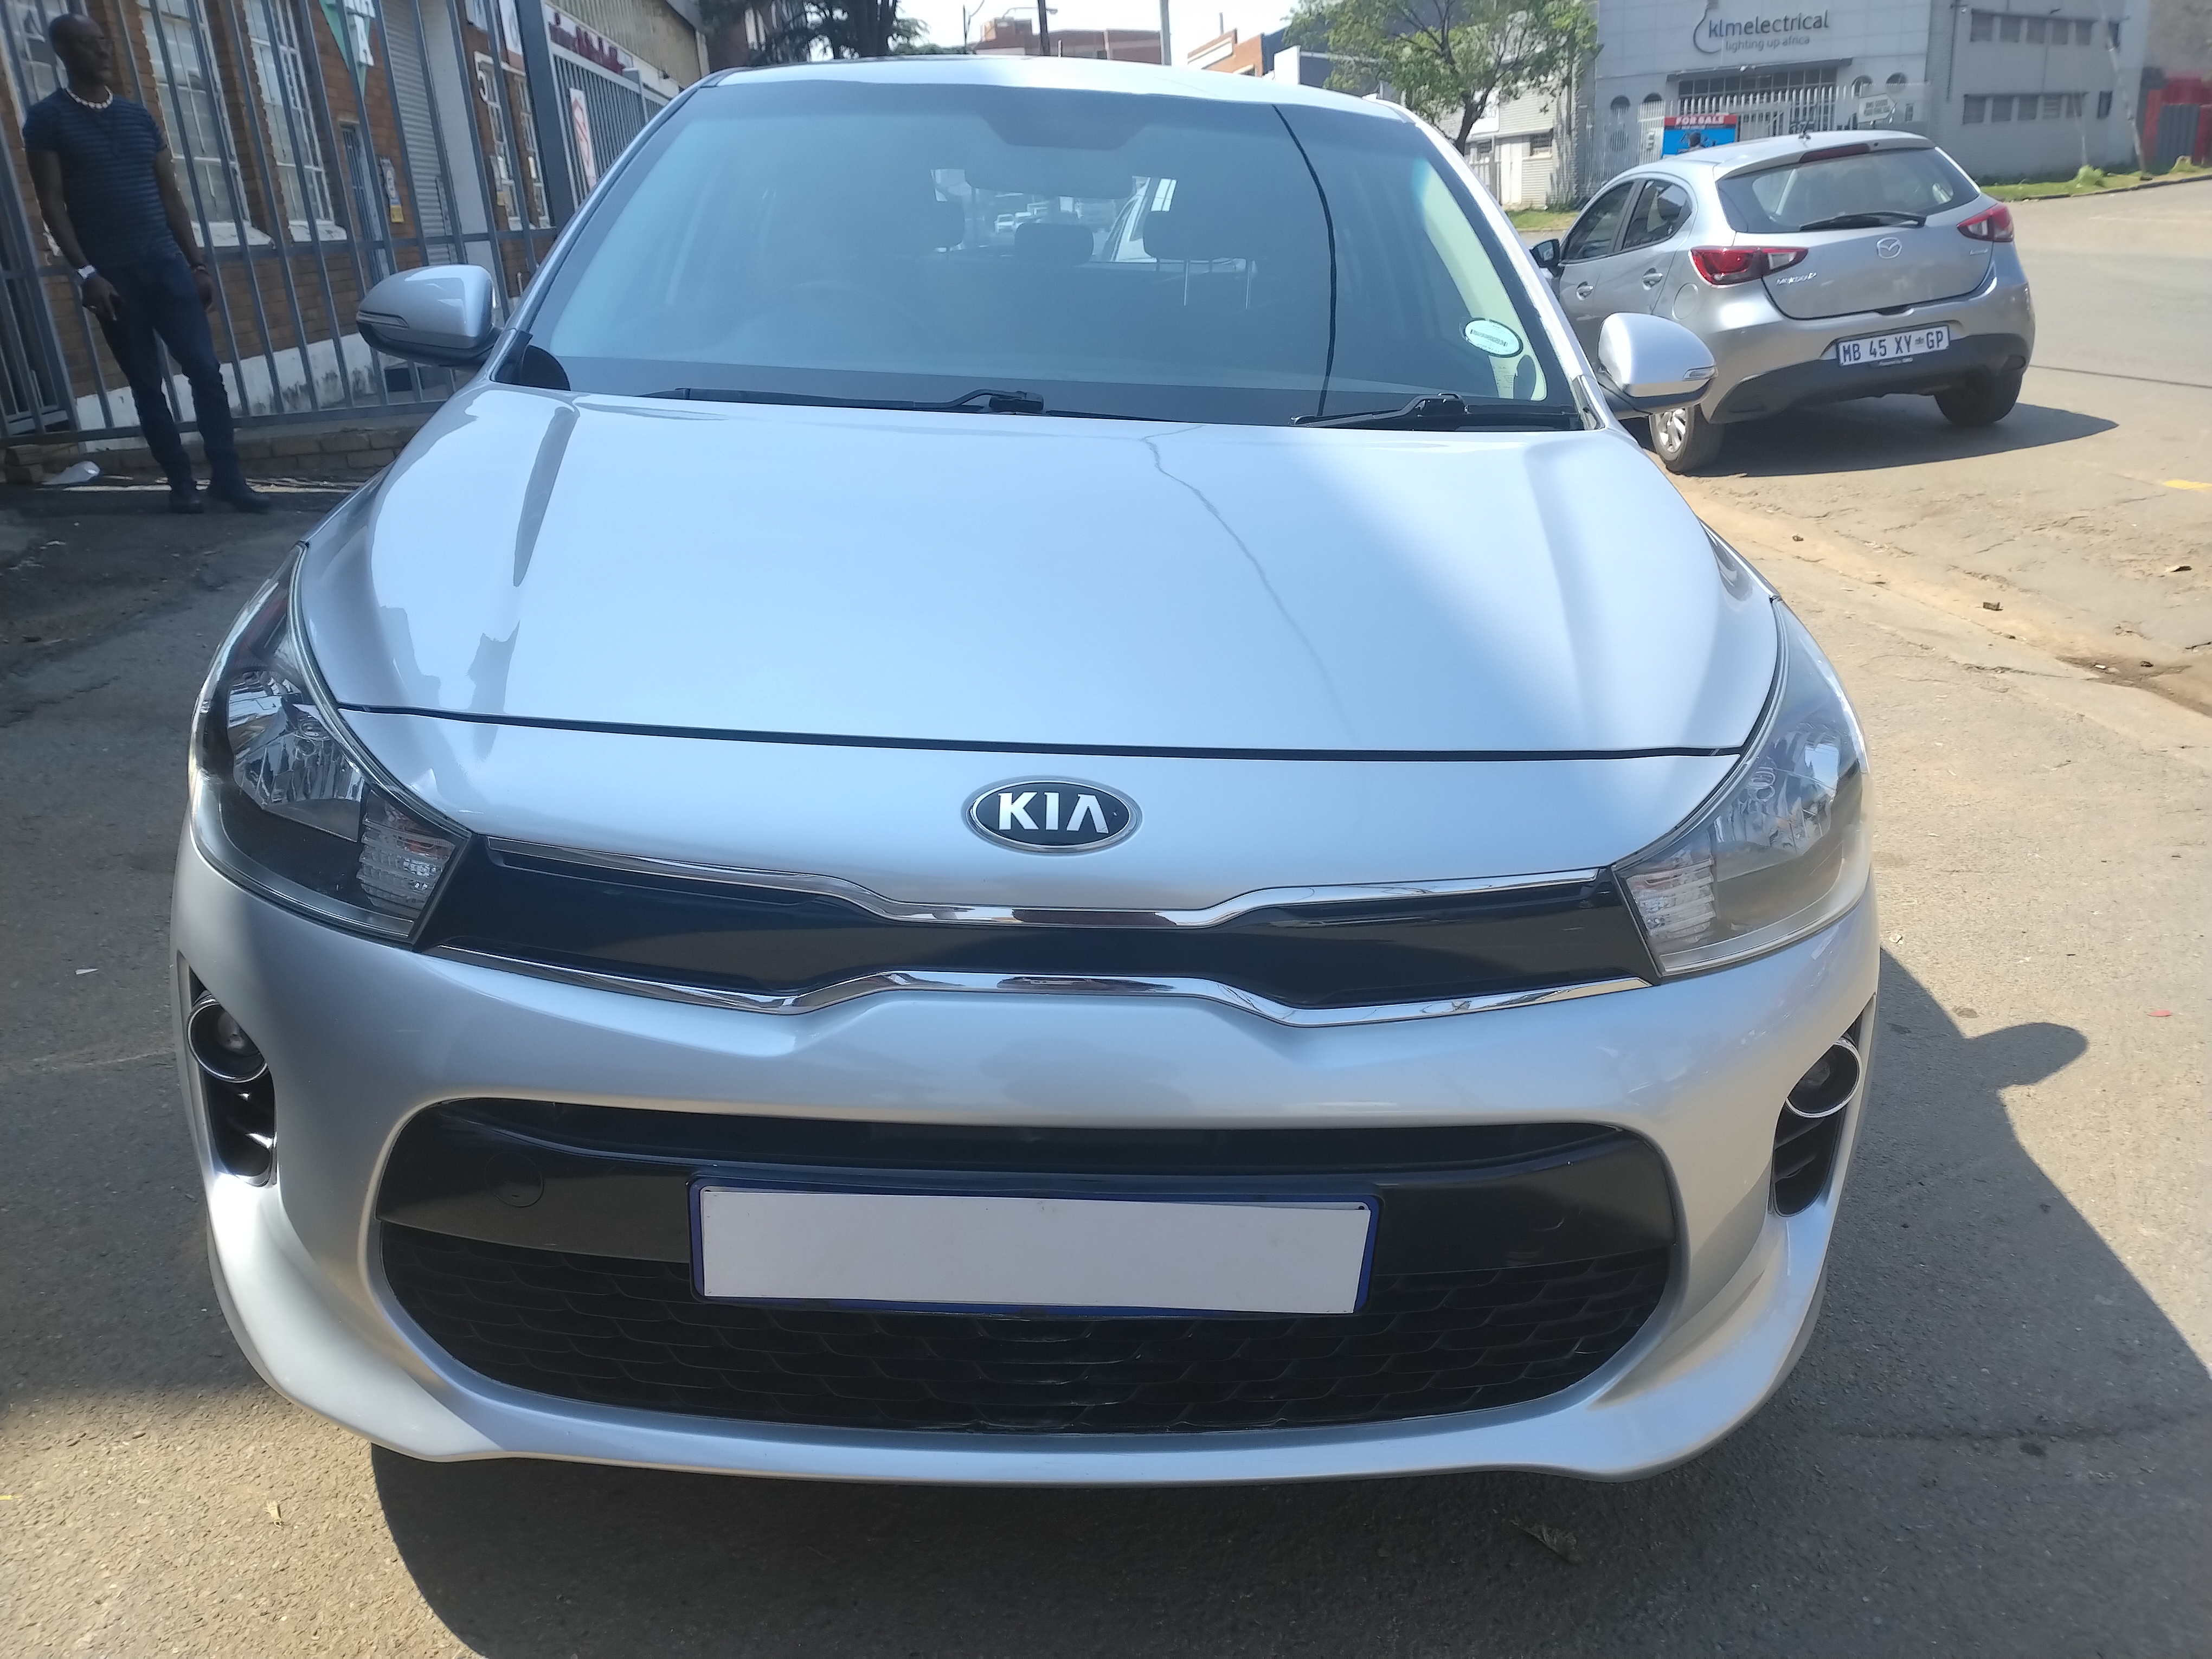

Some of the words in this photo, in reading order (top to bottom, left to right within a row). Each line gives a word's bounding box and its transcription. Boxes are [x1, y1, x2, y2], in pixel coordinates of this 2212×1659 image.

[1726, 40, 1764, 53] lighting
[1767, 39, 1779, 49] up
[1782, 35, 1810, 46] africa
[1675, 116, 1697, 125] FOR
[1843, 344, 1861, 362] MB
[1869, 339, 1887, 357] 45
[1895, 335, 1912, 355] XY
[1926, 330, 1944, 349] GP
[998, 792, 1109, 834] KIA
